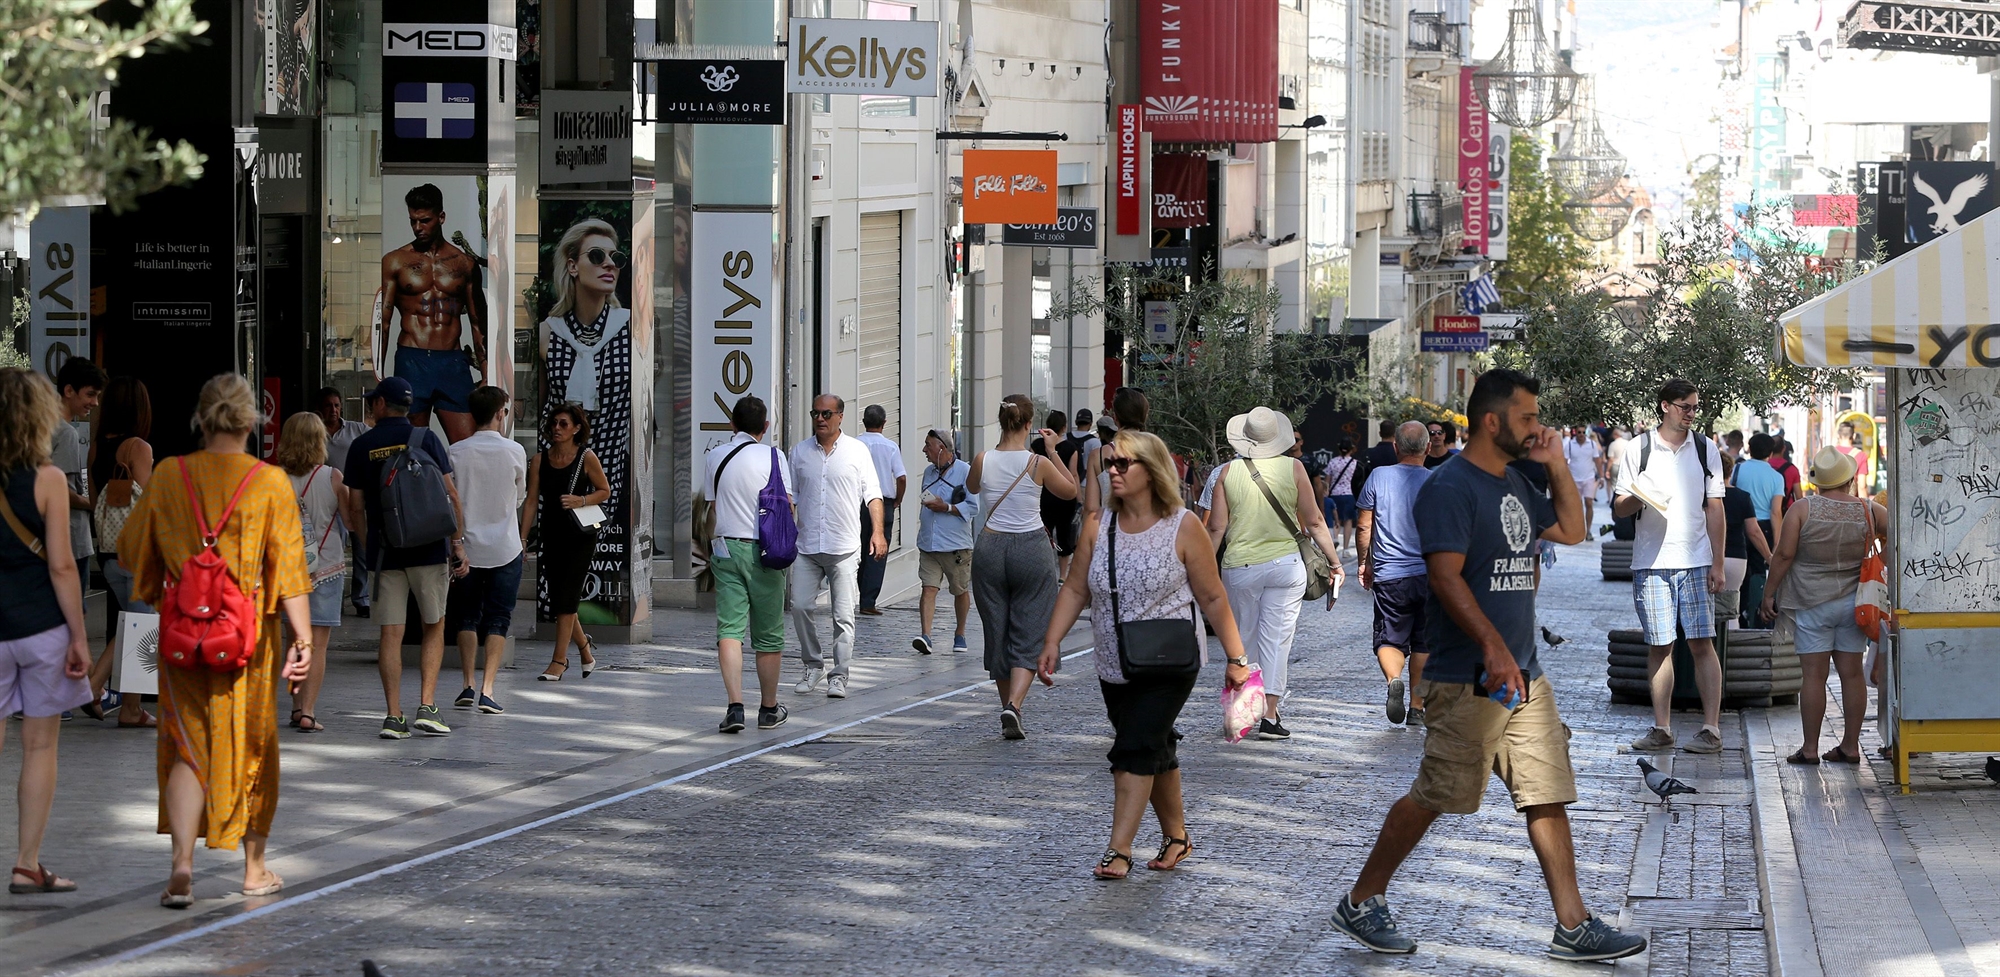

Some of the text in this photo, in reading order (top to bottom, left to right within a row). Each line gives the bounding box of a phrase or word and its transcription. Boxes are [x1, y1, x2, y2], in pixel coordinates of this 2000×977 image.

[388, 30, 485, 51] MED
[1162, 3, 1181, 82] FUNKY
[798, 25, 927, 88] kellys
[798, 80, 876, 88] ACCESSORIES
[669, 102, 771, 112] JULIA MORE
[1122, 108, 1135, 198] LAPIN HOUSE
[268, 152, 302, 179] MORE
[974, 175, 1006, 200] Folli
[1463, 166, 1482, 253] Hondos
[1048, 232, 1066, 241] 1968
[135, 242, 210, 253] Life is better in
[133, 259, 212, 272] #ItalianLingerie
[1439, 318, 1478, 329] Hondos
[1424, 336, 1485, 345] BERTO LUCCI
[588, 560, 623, 571] WAY
[1493, 556, 1534, 574] FRANKLI
[1489, 575, 1535, 592] MARSHAL
